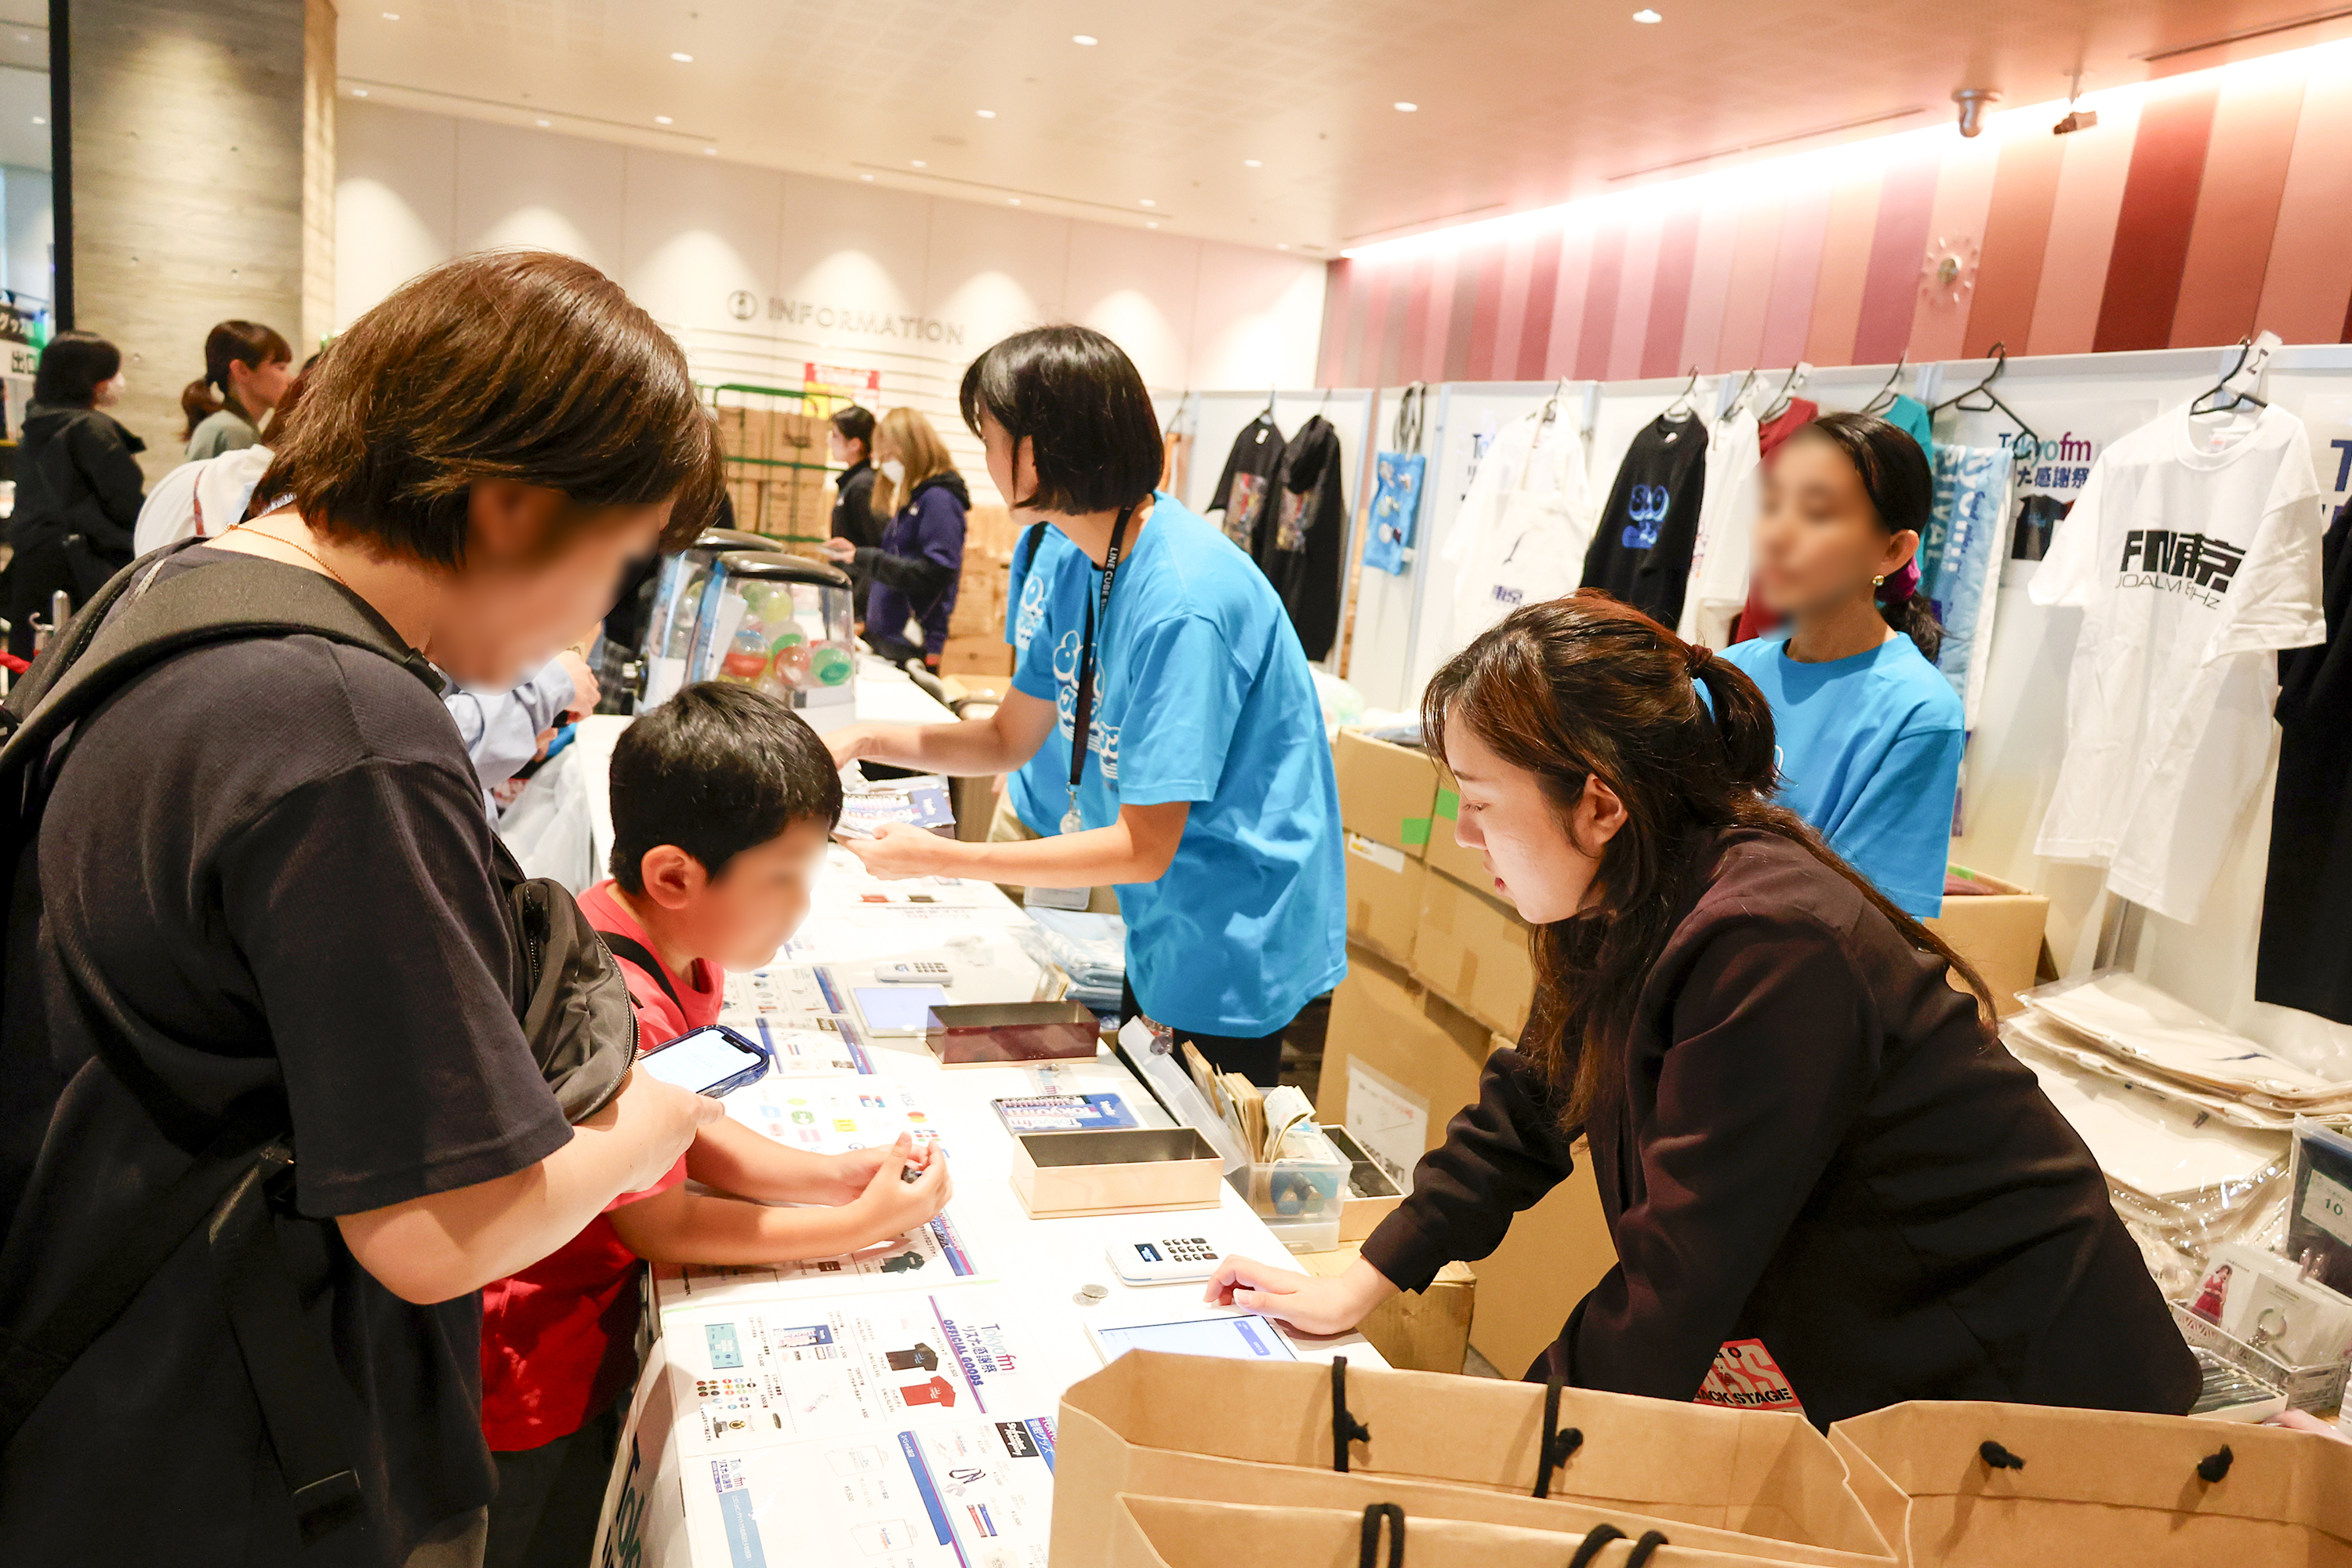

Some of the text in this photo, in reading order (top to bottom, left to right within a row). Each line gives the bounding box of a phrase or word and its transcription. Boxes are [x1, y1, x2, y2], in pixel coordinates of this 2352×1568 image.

[768, 297, 964, 345] INFORMATION
[1106, 547, 1118, 568] LINE
[1102, 571, 1112, 594] CUBE
[899, 1092, 915, 1105] VISA
[1011, 1116, 1076, 1126] Tokyofm
[2326, 1198, 2344, 1216] 10
[931, 1219, 953, 1248] ィシャルグッズ
[943, 1319, 983, 1386] OFFICIAL GOODS
[981, 1323, 1016, 1370] Tokyofm
[1695, 1388, 1793, 1404] ACK STAGE
[1029, 1420, 1054, 1451] 番組グッズ
[844, 1486, 854, 1501] ¥5,500
